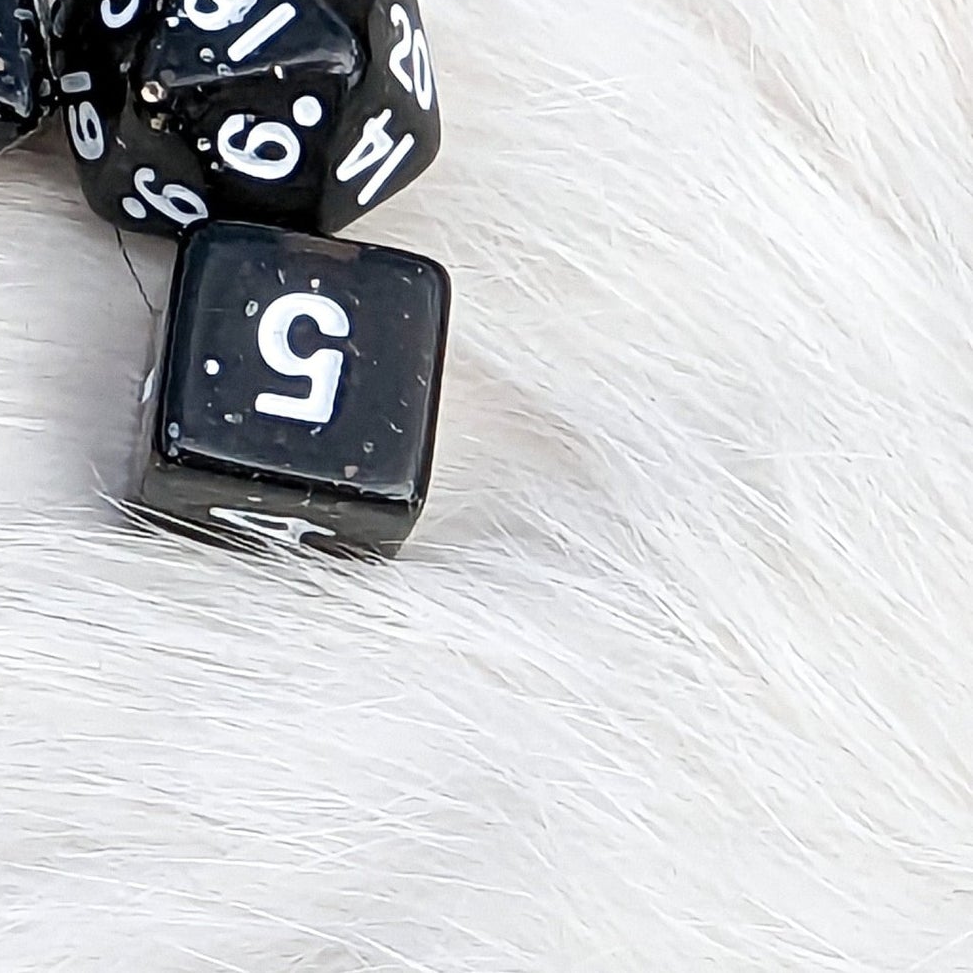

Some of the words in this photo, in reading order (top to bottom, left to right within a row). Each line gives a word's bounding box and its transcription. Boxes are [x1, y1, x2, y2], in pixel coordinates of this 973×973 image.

[389, 3, 433, 111] 20
[336, 108, 415, 206] 14
[255, 292, 350, 424] 5
